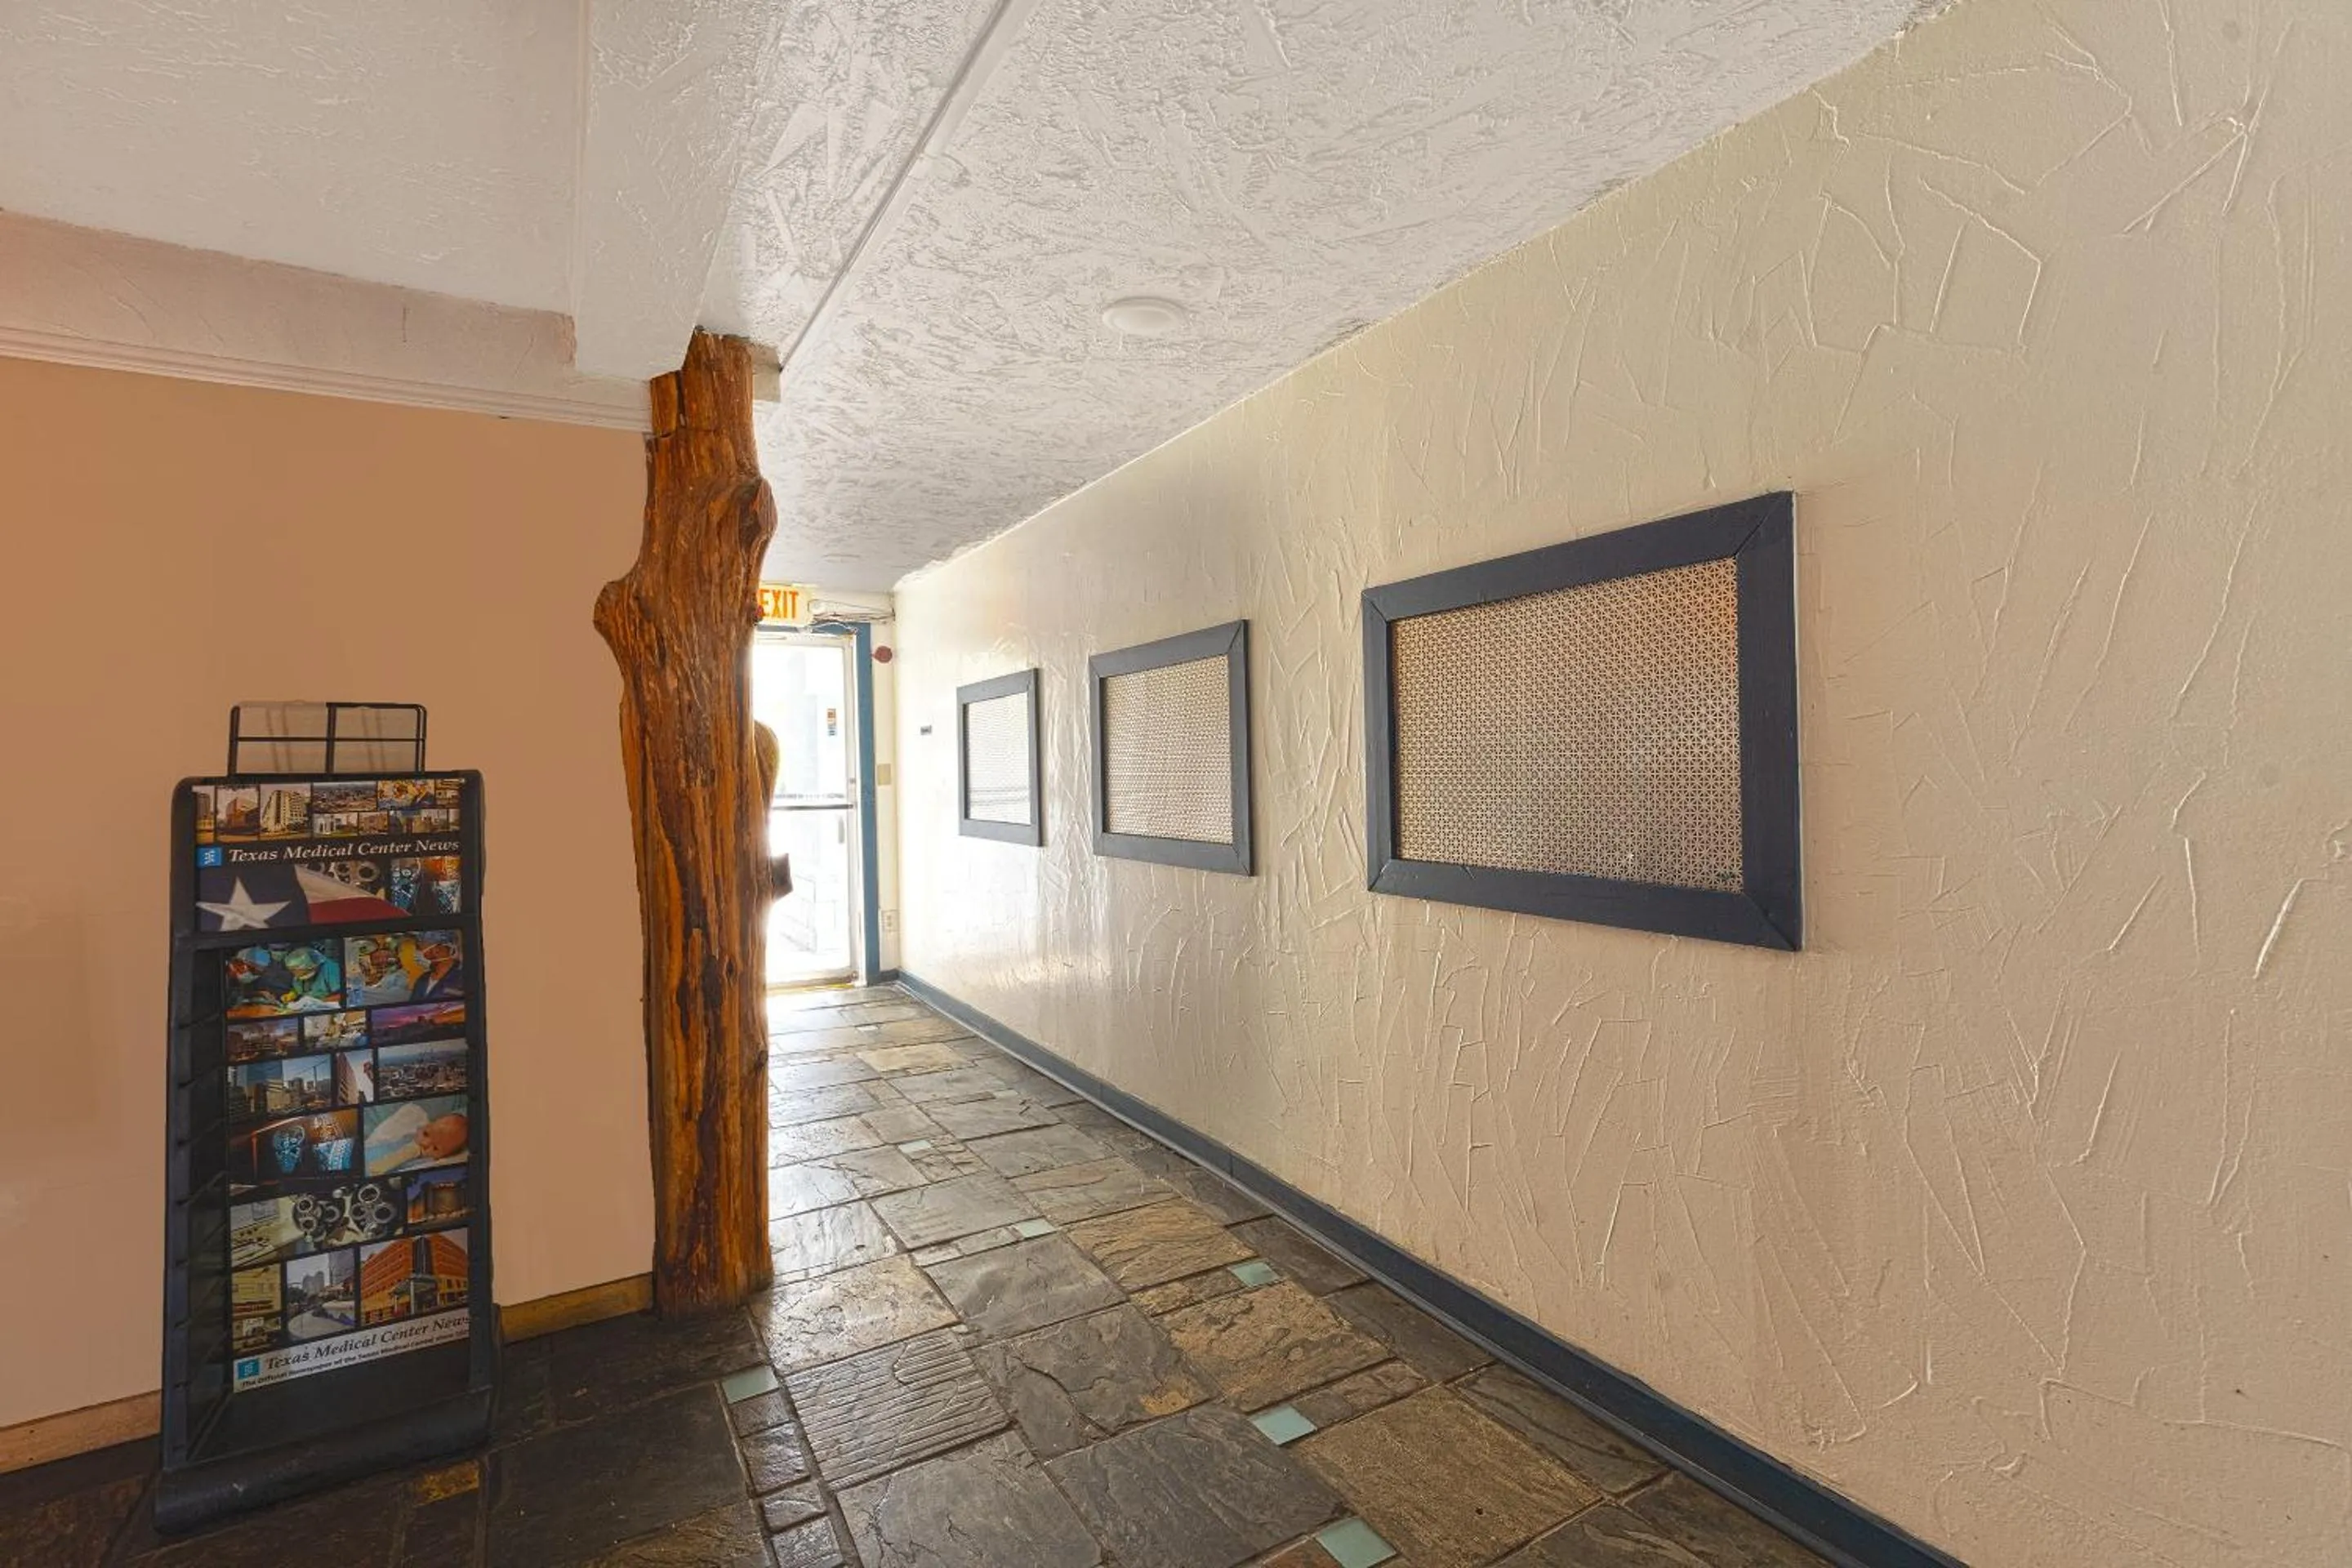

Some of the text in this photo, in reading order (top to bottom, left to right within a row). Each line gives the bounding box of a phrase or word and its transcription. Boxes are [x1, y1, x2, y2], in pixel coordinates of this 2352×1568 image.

[759, 589, 800, 619] EXIT
[229, 839, 461, 863] Texas Medical Center News
[266, 1351, 310, 1370] Texas
[314, 1334, 378, 1359] Medical
[380, 1324, 430, 1344] Center
